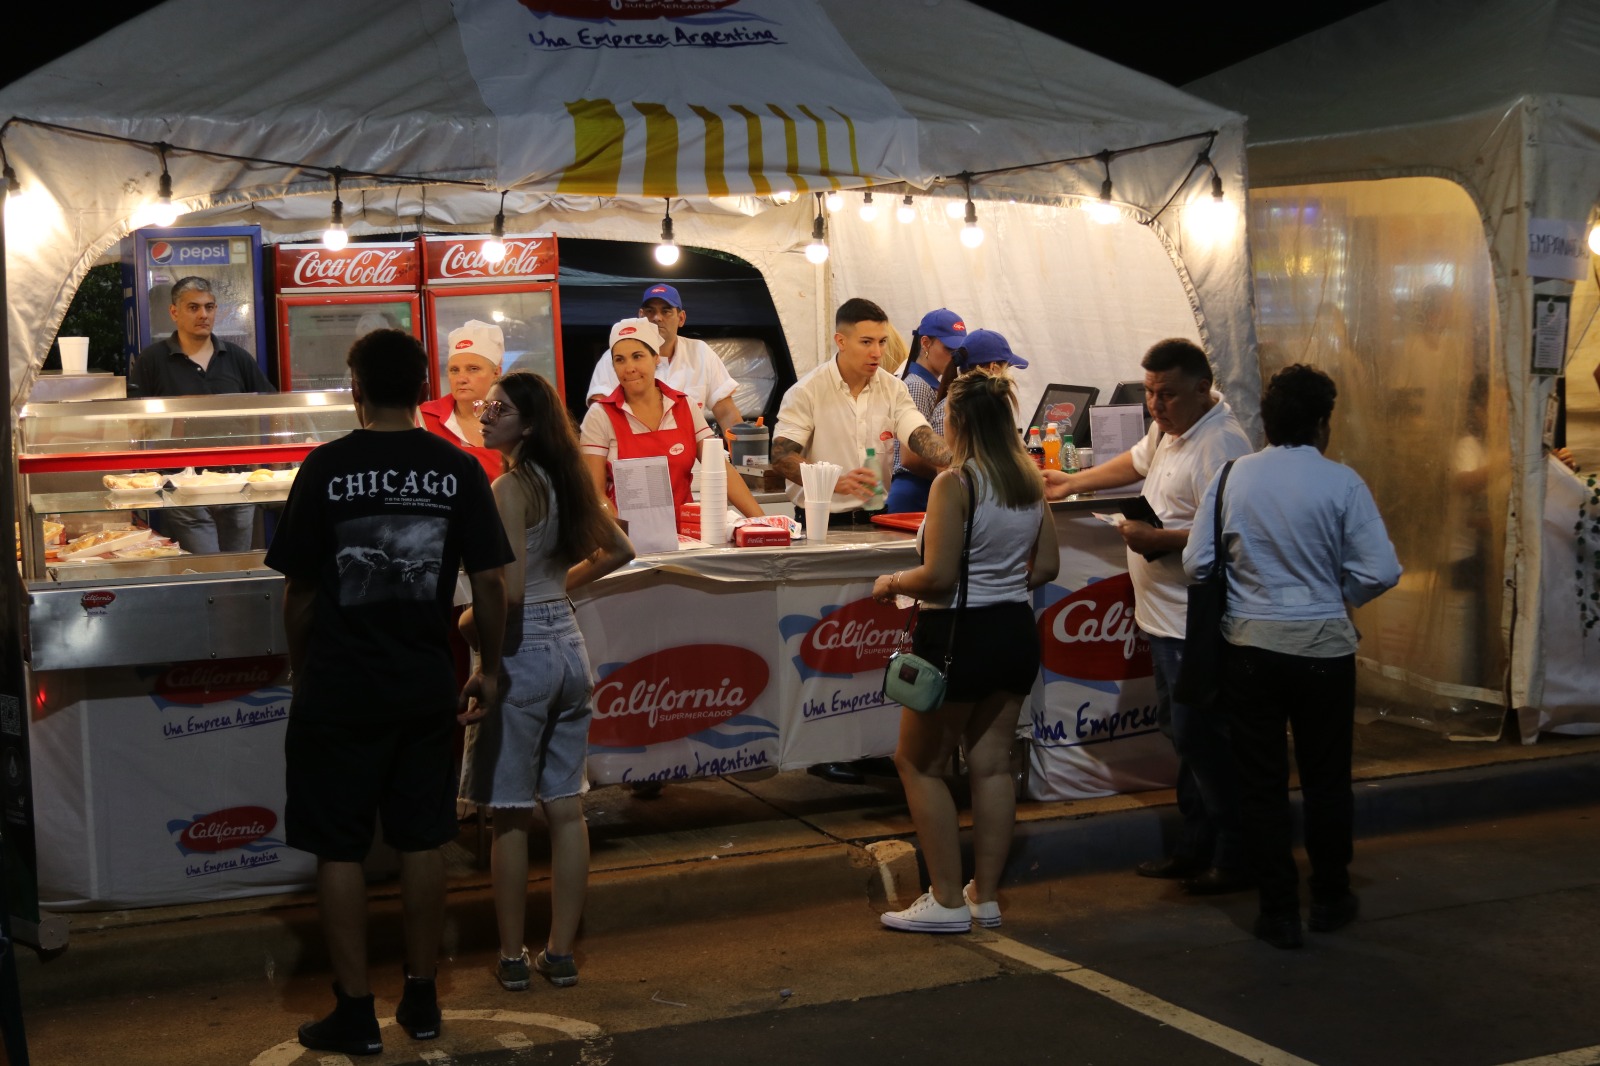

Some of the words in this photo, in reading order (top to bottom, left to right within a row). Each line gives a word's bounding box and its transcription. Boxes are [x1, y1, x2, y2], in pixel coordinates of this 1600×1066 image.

[529, 33, 570, 47] Una
[578, 28, 668, 47] Empresa
[675, 27, 778, 47] Argentina
[180, 244, 225, 261] pepsi
[293, 249, 403, 285] Coca-Cola
[440, 241, 542, 278] CocaCola
[328, 469, 457, 501] CHICAGO
[812, 619, 913, 659] Californ
[1053, 599, 1142, 660] Calif
[166, 664, 269, 694] California
[592, 677, 747, 729] California
[659, 709, 733, 722] SUPERMERCADOS
[803, 699, 826, 718] Una
[832, 690, 885, 713] Empresa
[163, 722, 183, 737] Una
[188, 716, 232, 733] Empresa
[236, 706, 286, 725] Argentina
[1076, 702, 1158, 741] Empresa
[188, 821, 266, 844] California
[186, 866, 202, 876] Una
[204, 860, 238, 873] Empresa
[240, 852, 278, 868] Argentina
